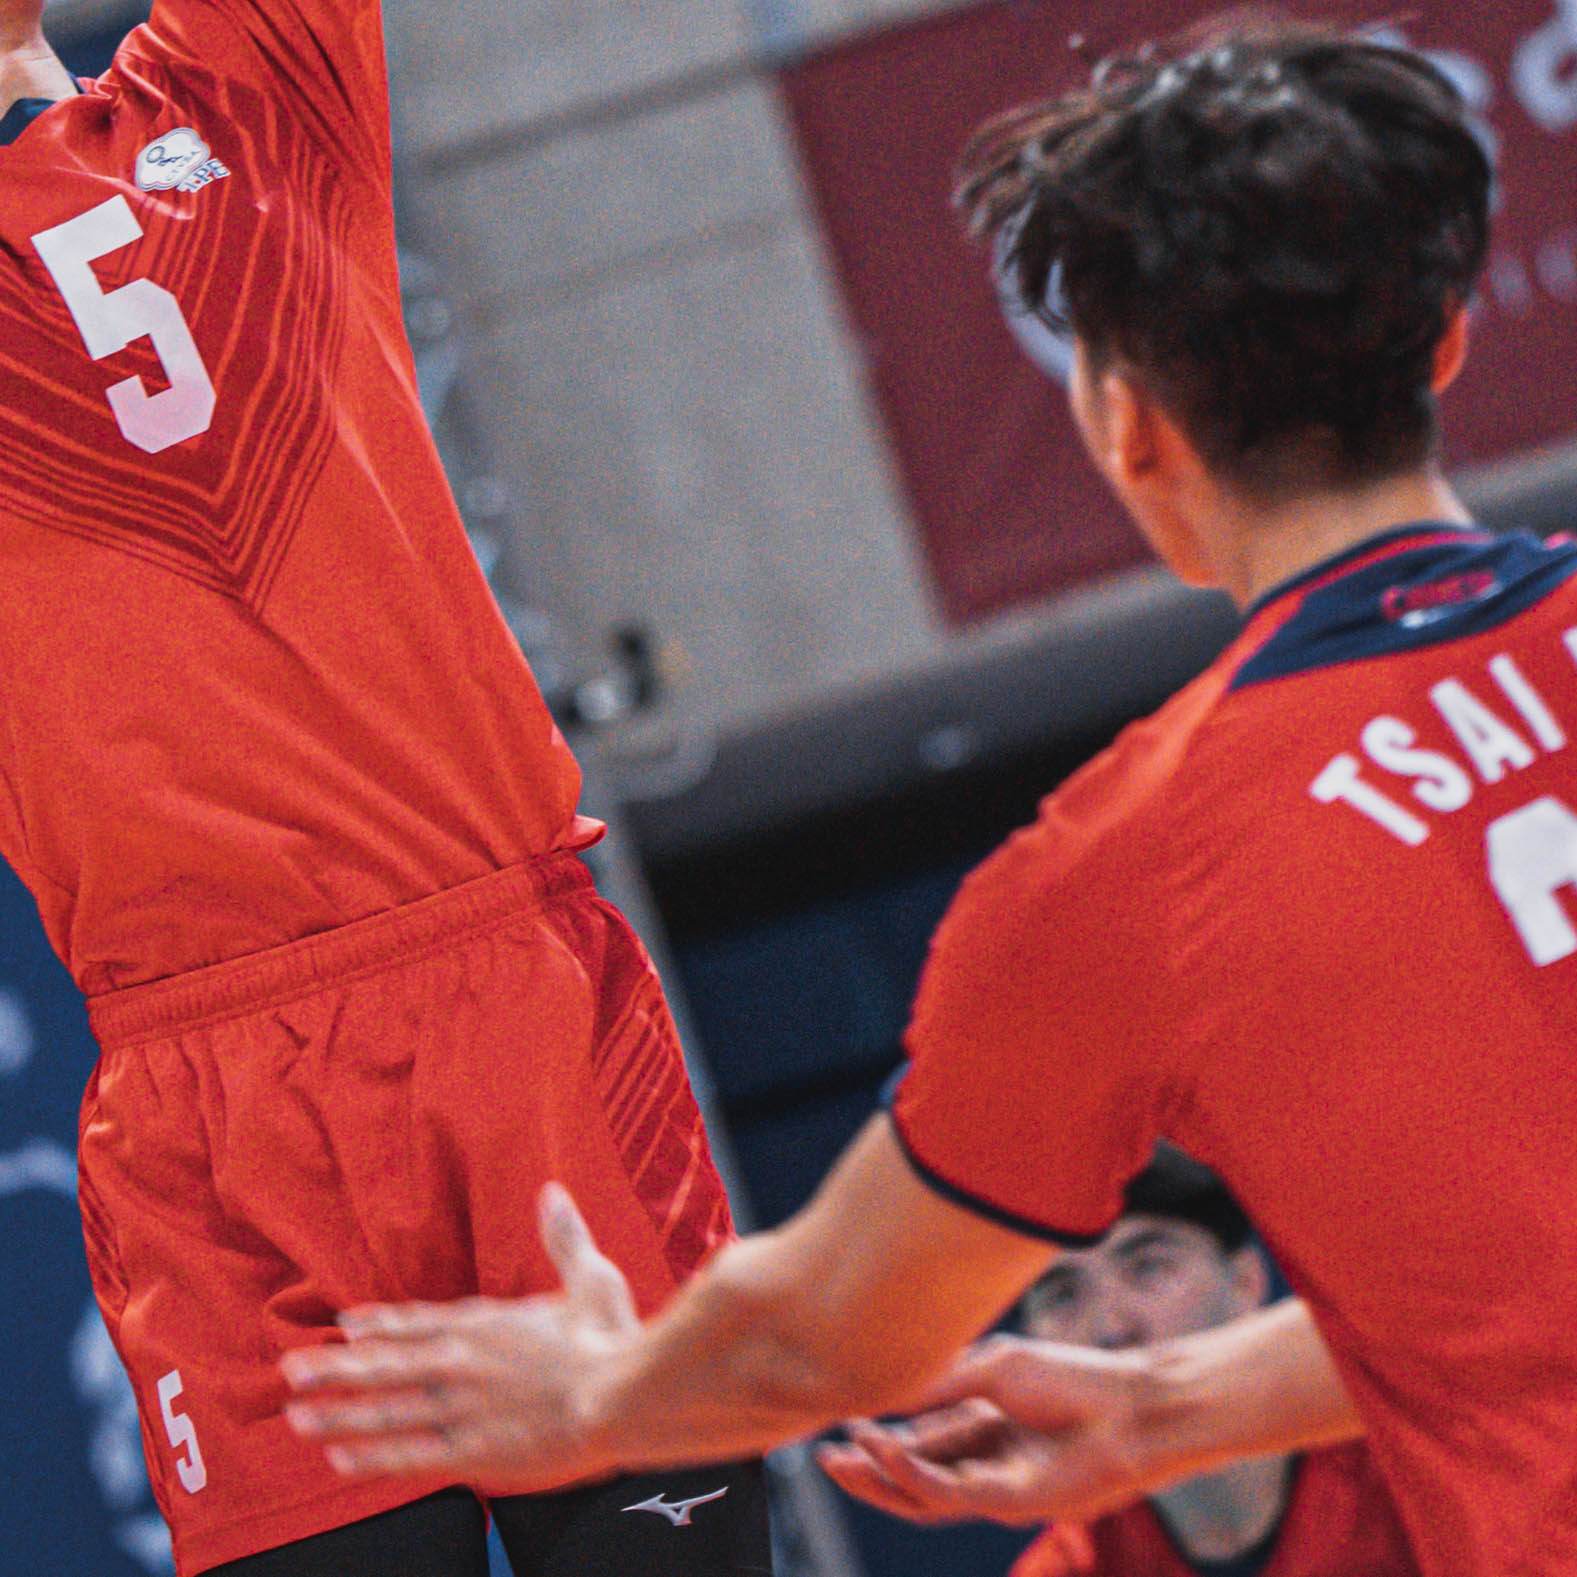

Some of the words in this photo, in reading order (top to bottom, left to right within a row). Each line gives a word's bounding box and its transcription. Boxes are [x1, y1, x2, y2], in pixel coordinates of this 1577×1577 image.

[31, 194, 217, 454] 5
[1310, 653, 1566, 846] TSAI
[157, 1370, 207, 1494] 5
